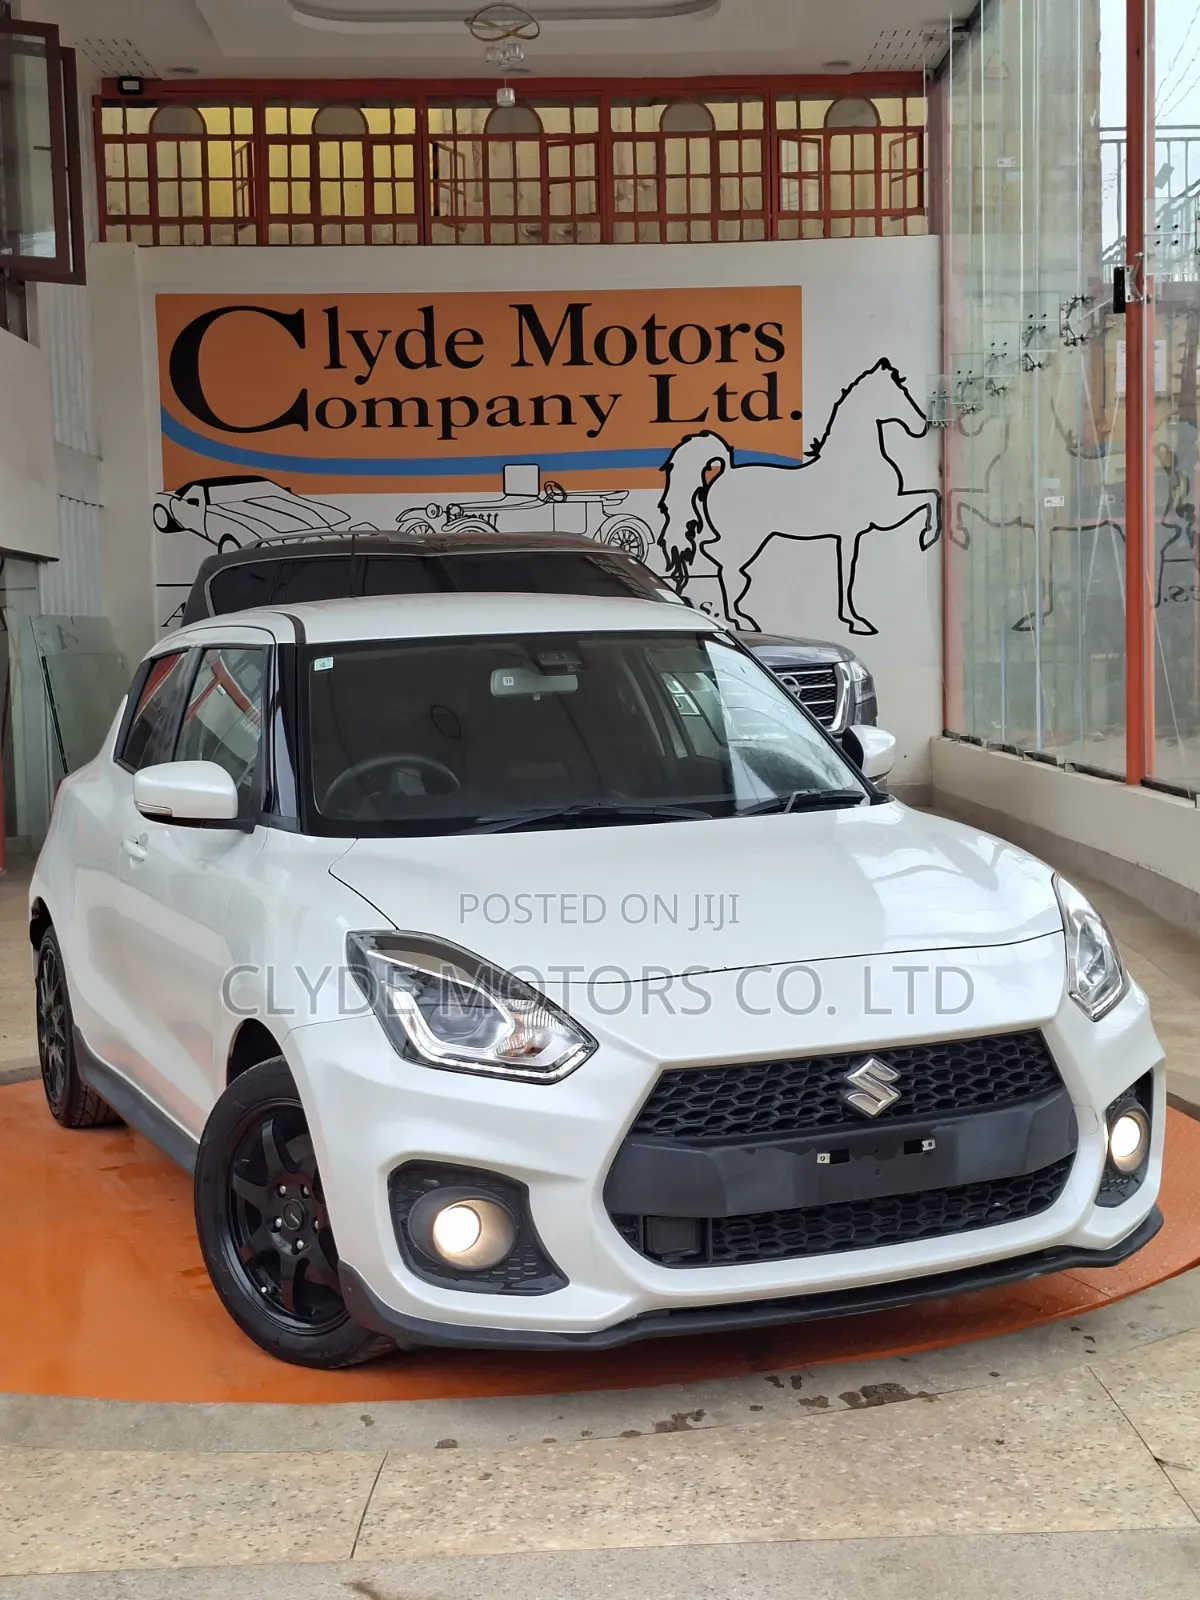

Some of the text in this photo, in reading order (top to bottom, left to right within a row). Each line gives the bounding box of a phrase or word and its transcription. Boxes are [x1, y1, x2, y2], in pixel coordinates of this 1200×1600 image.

[168, 302, 785, 434] Clyde Motors
[648, 371, 803, 424] Ltd.
